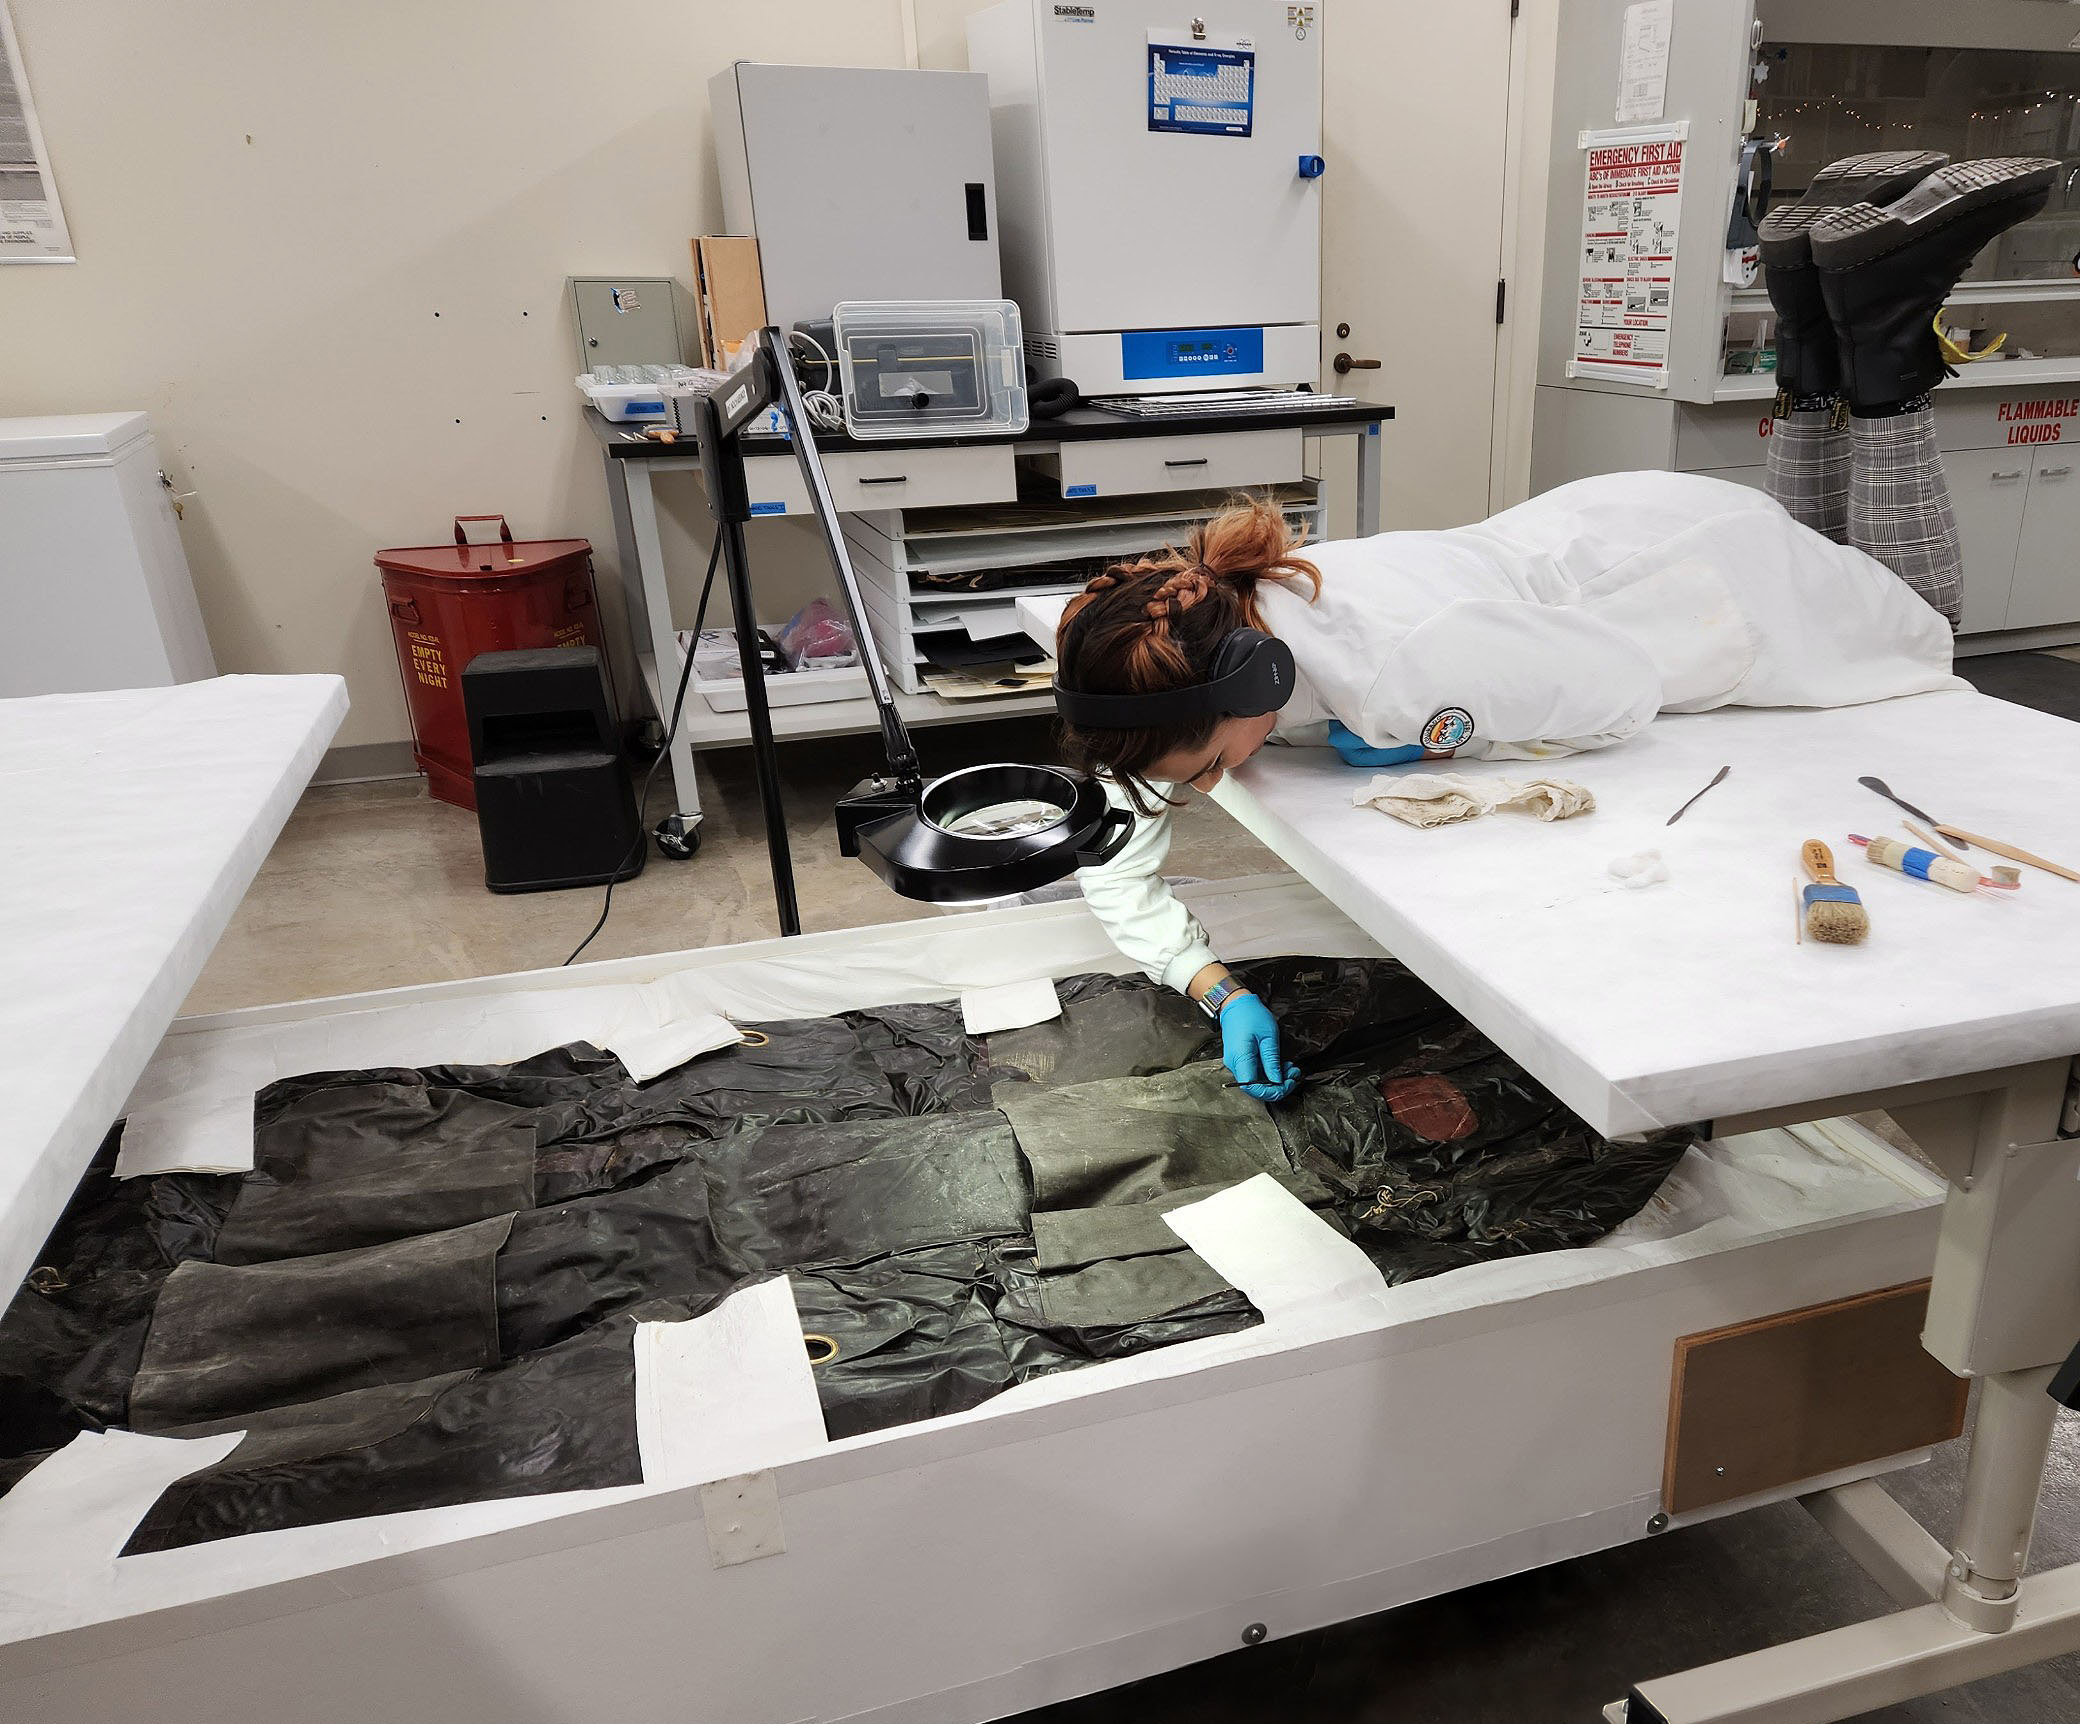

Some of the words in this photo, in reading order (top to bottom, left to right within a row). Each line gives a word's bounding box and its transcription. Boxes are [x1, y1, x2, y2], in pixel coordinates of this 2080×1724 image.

[1053, 5, 1095, 17] StableTemp
[1590, 147, 1640, 166] EMERGENCY
[1641, 143, 1666, 162] FIRST
[1667, 142, 1683, 160] AID
[1589, 170, 1603, 181] ABC's
[1603, 170, 1610, 180] OF
[1610, 168, 1637, 179] IMMEDIATE
[1637, 167, 1652, 177] FIRST
[1652, 166, 1661, 176] AID
[1662, 164, 1681, 175] ACTION
[1632, 319, 1648, 327] LOCATION
[1613, 333, 1633, 341] EMERGENCY
[1612, 349, 1629, 357] NUMBERS
[1998, 399, 2079, 421] FLAMMABLE
[2008, 423, 2061, 444] LIQUIDS
[411, 644, 441, 662] EMPTY
[413, 658, 446, 676] EVERY
[418, 671, 447, 689] NIGHT
